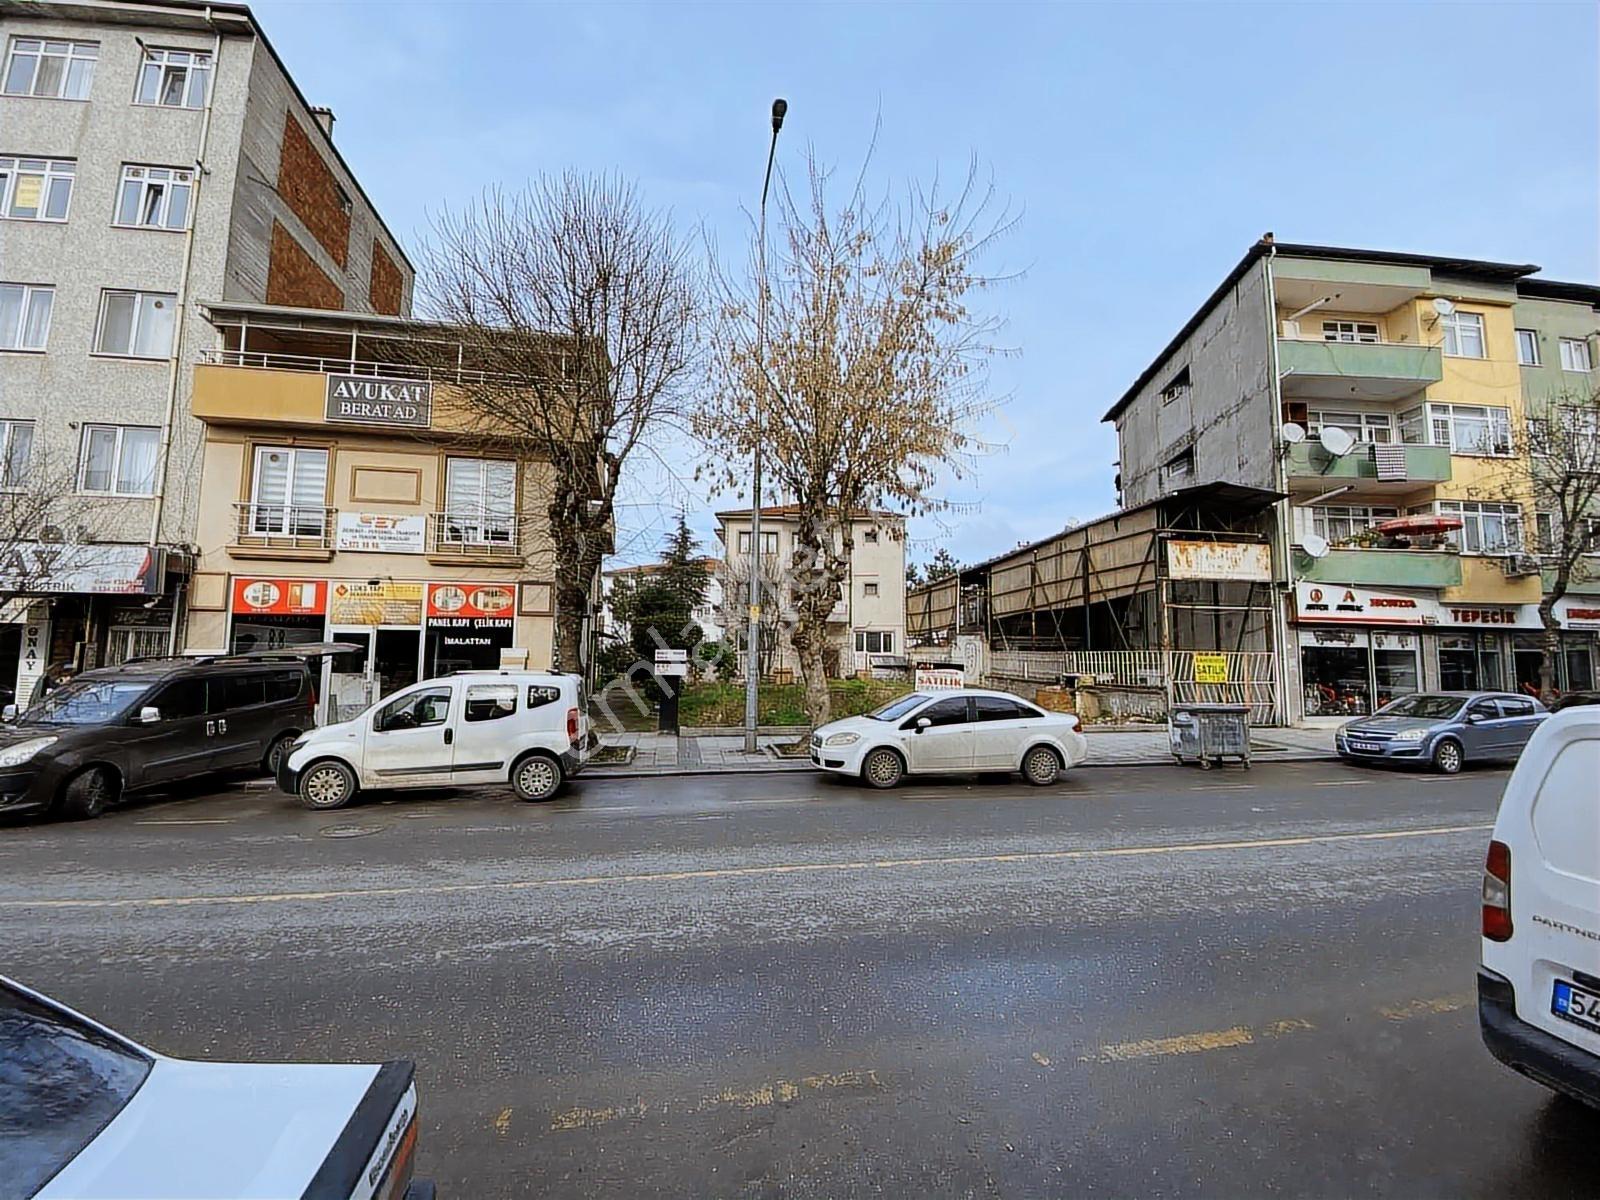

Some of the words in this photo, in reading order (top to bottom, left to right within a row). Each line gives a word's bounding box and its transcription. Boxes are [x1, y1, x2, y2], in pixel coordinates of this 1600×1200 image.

[333, 381, 425, 402] AVUKAT
[340, 401, 392, 417] BERAT
[1369, 598, 1417, 608] HONDA
[1532, 914, 1600, 941] PARTNE
[1571, 990, 1600, 1023] 54
